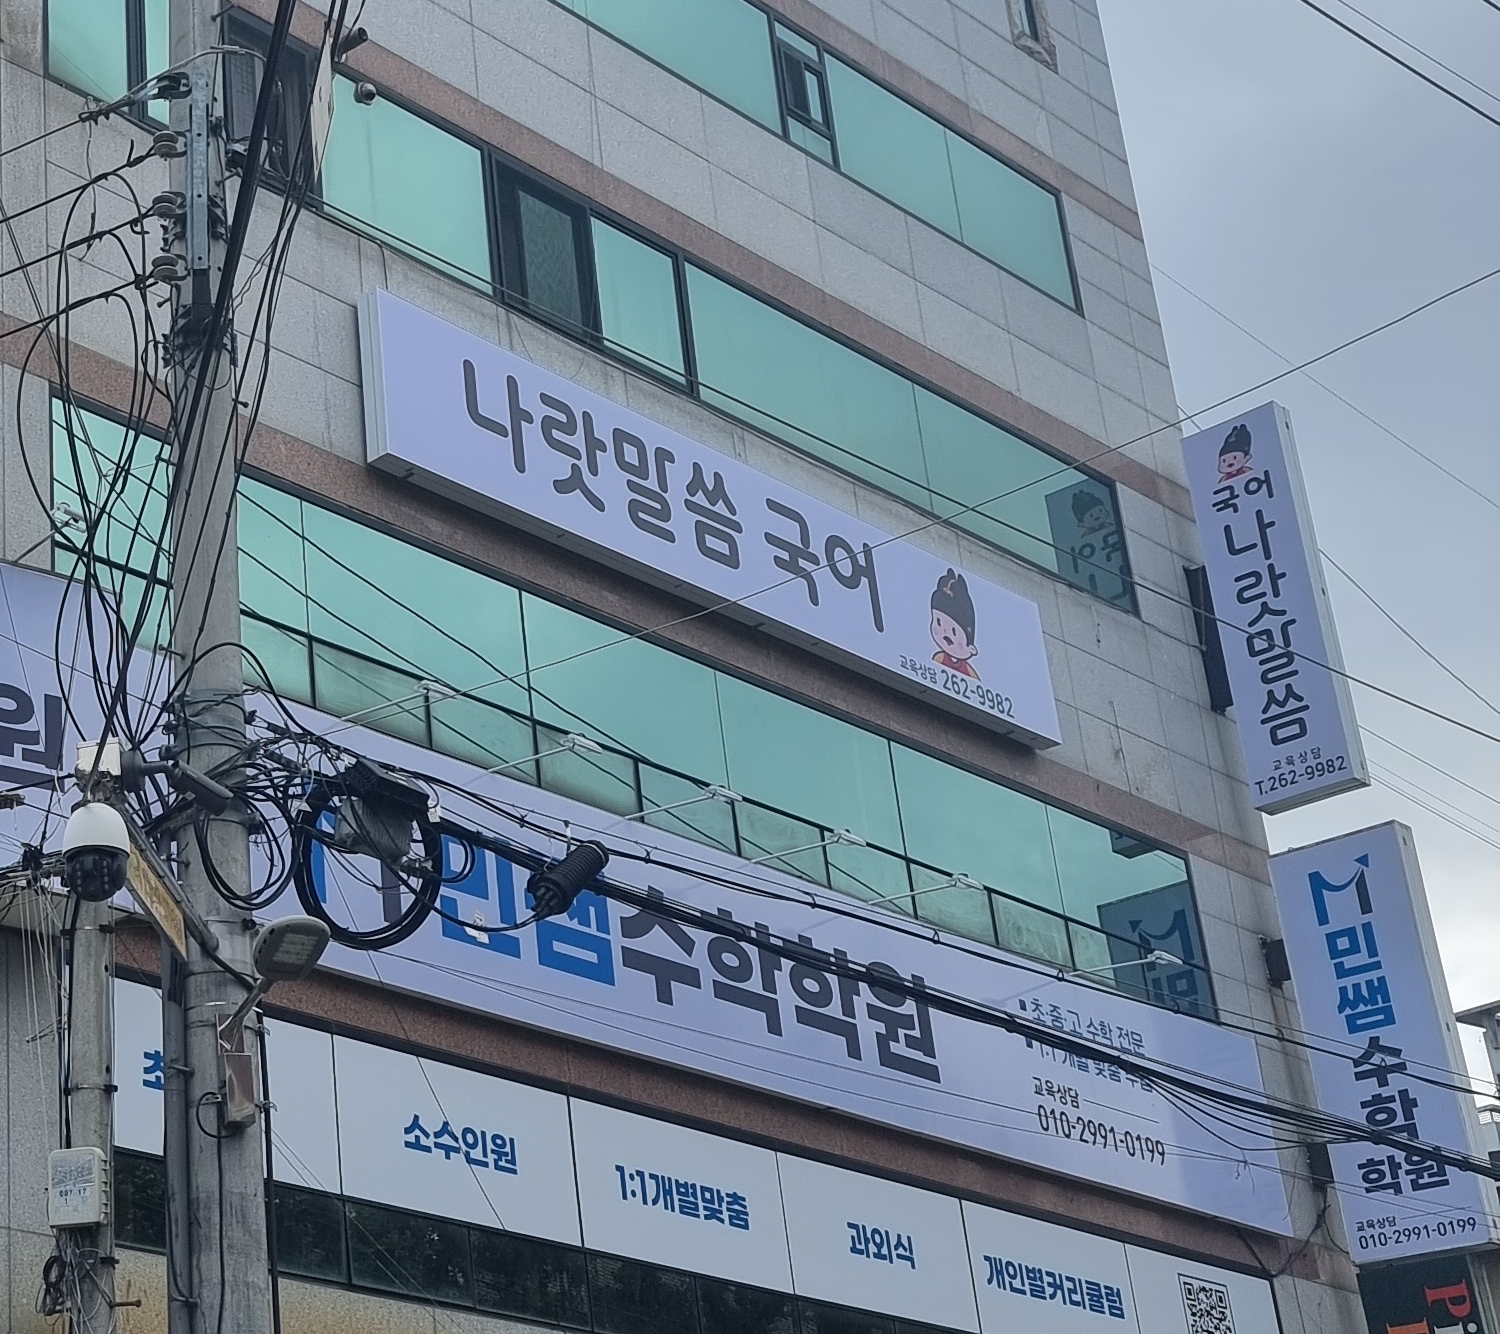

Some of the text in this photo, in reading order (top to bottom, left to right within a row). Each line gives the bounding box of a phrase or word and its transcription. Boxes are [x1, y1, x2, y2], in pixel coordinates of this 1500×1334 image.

[462, 358, 885, 633] 나랏말씀 국어
[1211, 469, 1275, 515] 국어
[1223, 508, 1311, 747] 나랏말씀
[941, 670, 1015, 719] 262-9982
[1254, 755, 1348, 797] T.262-9982
[1086, 1017, 1113, 1047] 수학
[1116, 1026, 1146, 1057] 전문
[1032, 1076, 1080, 1109] 교육상담
[404, 1114, 518, 1175] 소수인원
[1037, 1104, 1166, 1166] 010-2991-0199
[614, 1164, 750, 1230] 1:1개별맞춤
[847, 1221, 917, 1270] 과외식
[1358, 1217, 1477, 1250] 010-2991-0199
[983, 1254, 1126, 1319] 개인별커리큘럼
